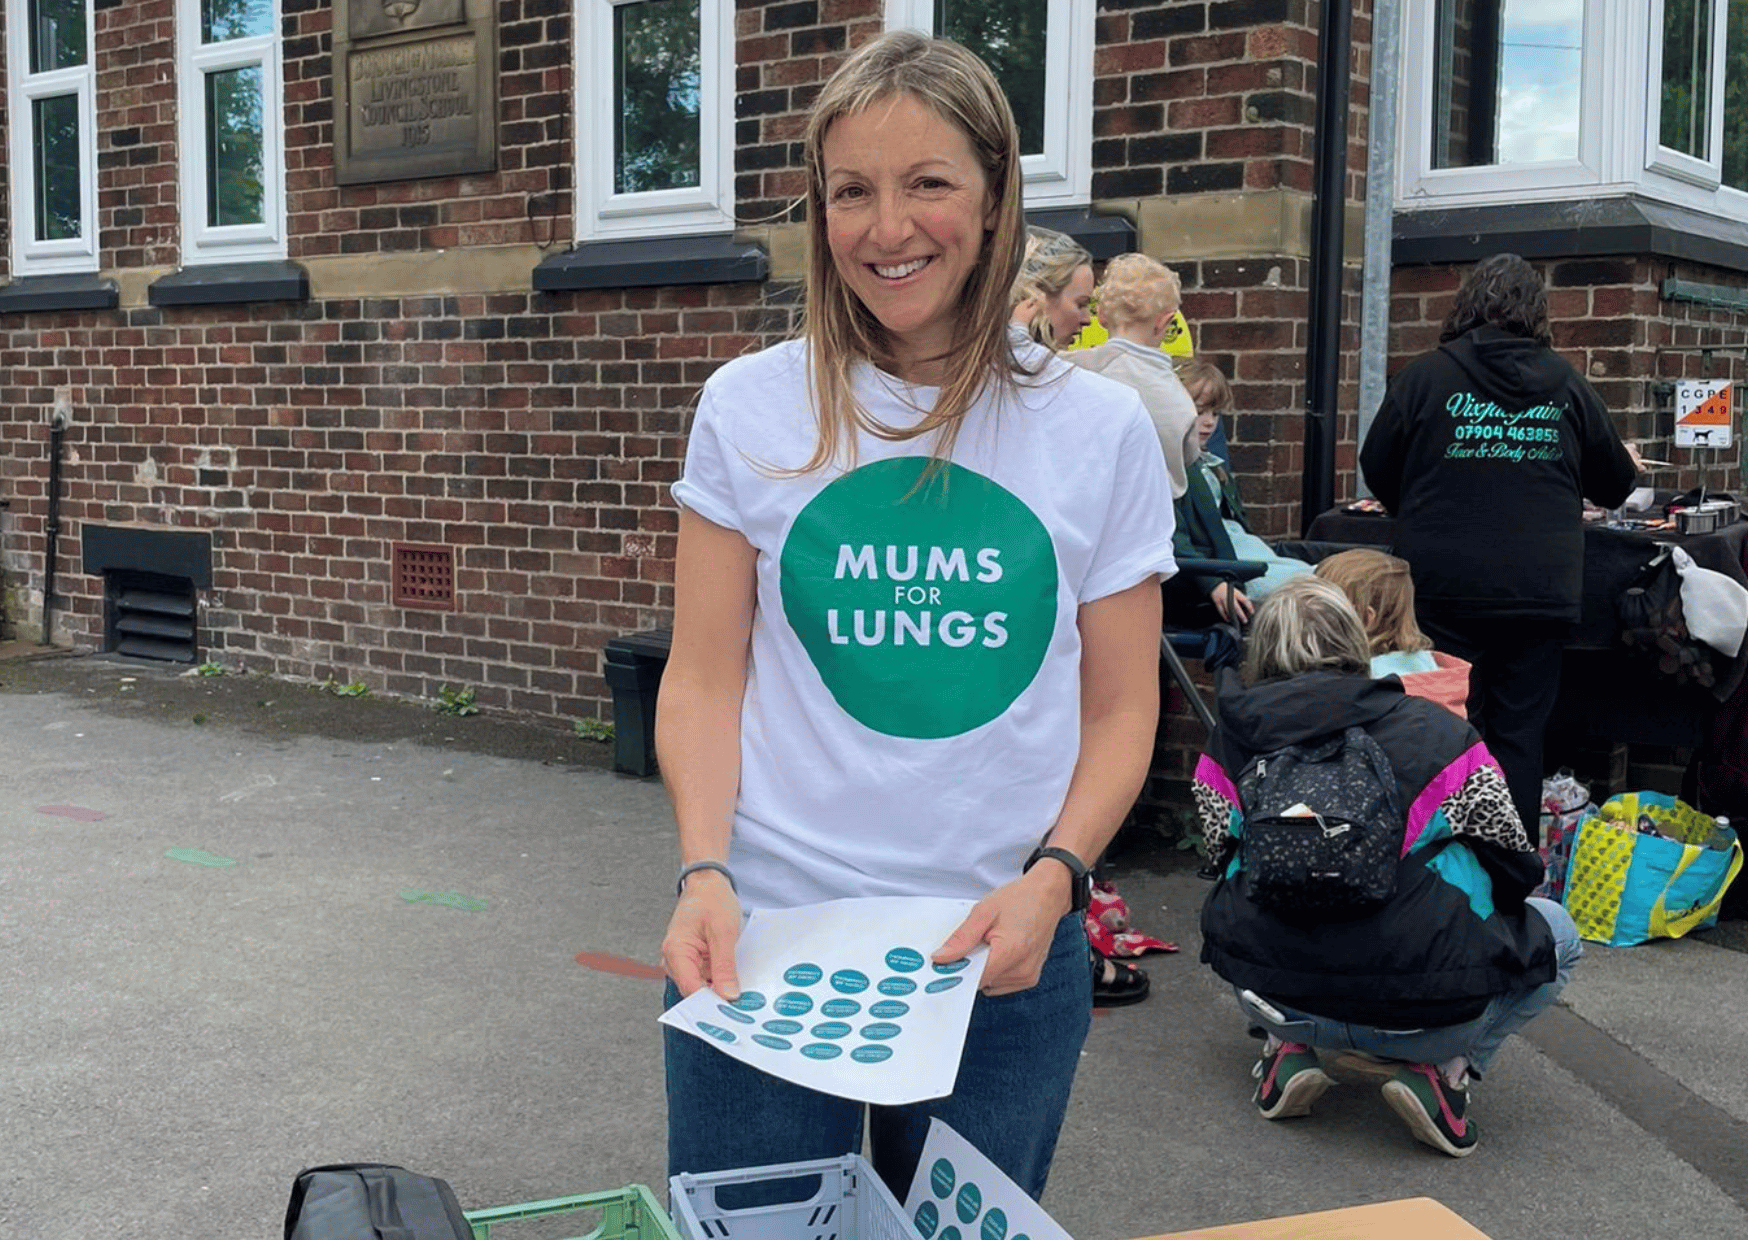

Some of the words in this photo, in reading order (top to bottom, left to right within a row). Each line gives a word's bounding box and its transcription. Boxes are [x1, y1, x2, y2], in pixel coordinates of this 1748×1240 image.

[361, 103, 417, 127] COUNCIL
[419, 95, 472, 120] SCHOOL
[1455, 425, 1503, 439] 07904
[1507, 426, 1560, 443] 463855
[1475, 442, 1488, 458] &
[1487, 442, 1526, 463] Body
[834, 544, 1003, 583] MUMS
[894, 586, 941, 605] FOR
[827, 609, 1009, 648] LUNGS
